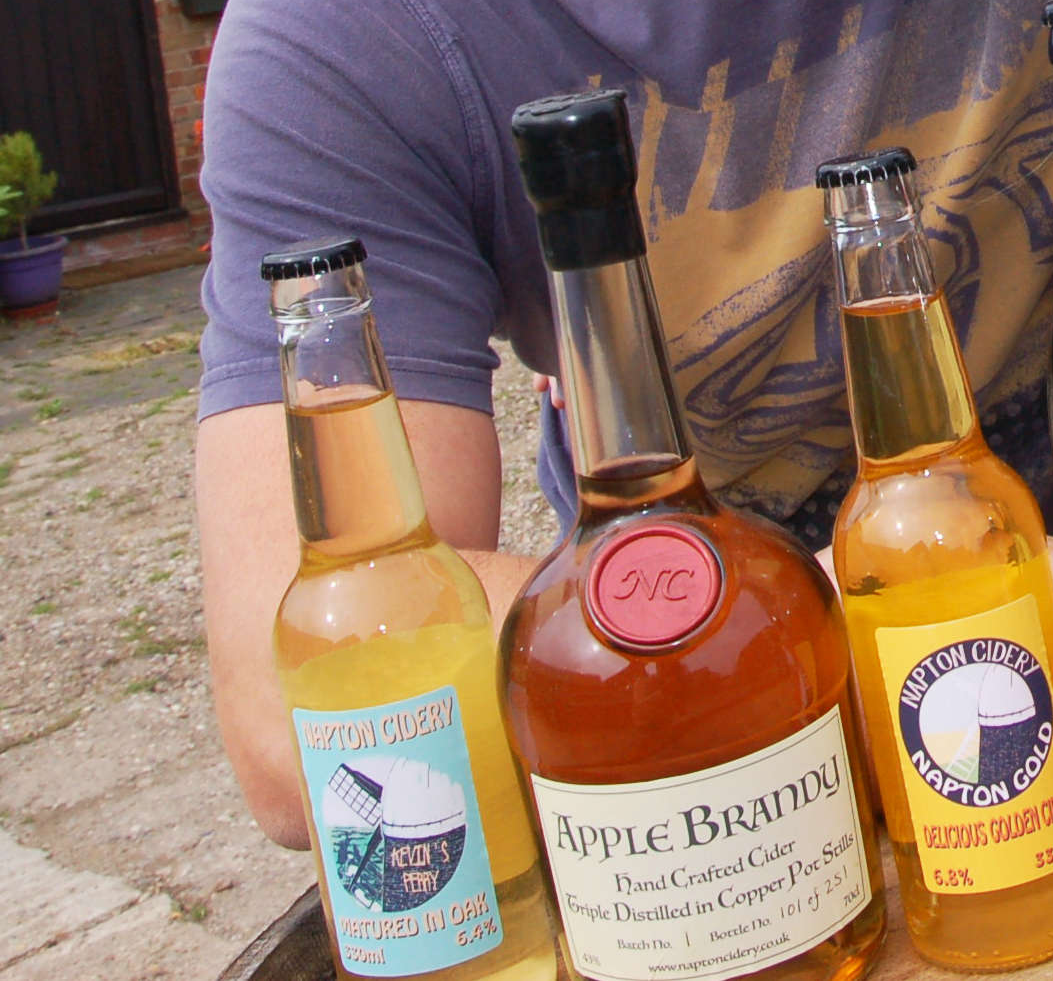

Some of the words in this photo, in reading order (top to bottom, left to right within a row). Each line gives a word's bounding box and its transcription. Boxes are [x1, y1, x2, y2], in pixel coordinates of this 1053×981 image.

[613, 569, 695, 601] NC
[901, 644, 967, 710] NAPTON
[971, 639, 1040, 677] CIDERY
[303, 721, 377, 751] NAPTON
[380, 696, 454, 745] CIDERY
[911, 749, 1010, 806] NAPTON
[1013, 721, 1053, 791] GOLD
[923, 821, 988, 849] DELICIOUS
[990, 810, 1039, 845] GOLDEN
[402, 870, 440, 893] PERRY
[565, 893, 610, 922] Triple
[613, 901, 691, 922] Distilled
[696, 896, 713, 914] in
[717, 875, 786, 910] Copper
[787, 859, 822, 893] Pot
[822, 833, 855, 865] Stills
[614, 873, 666, 895] Hand
[670, 859, 744, 890] Crafted
[747, 839, 796, 868] Cider
[933, 868, 974, 886] 6.8%
[340, 914, 420, 941] MATURED
[424, 911, 446, 934] IN
[451, 891, 490, 926] OAK
[455, 918, 498, 946] 6.4%
[617, 939, 650, 950] Batch
[710, 925, 750, 943] Bottle
[344, 945, 386, 964] 330ml
